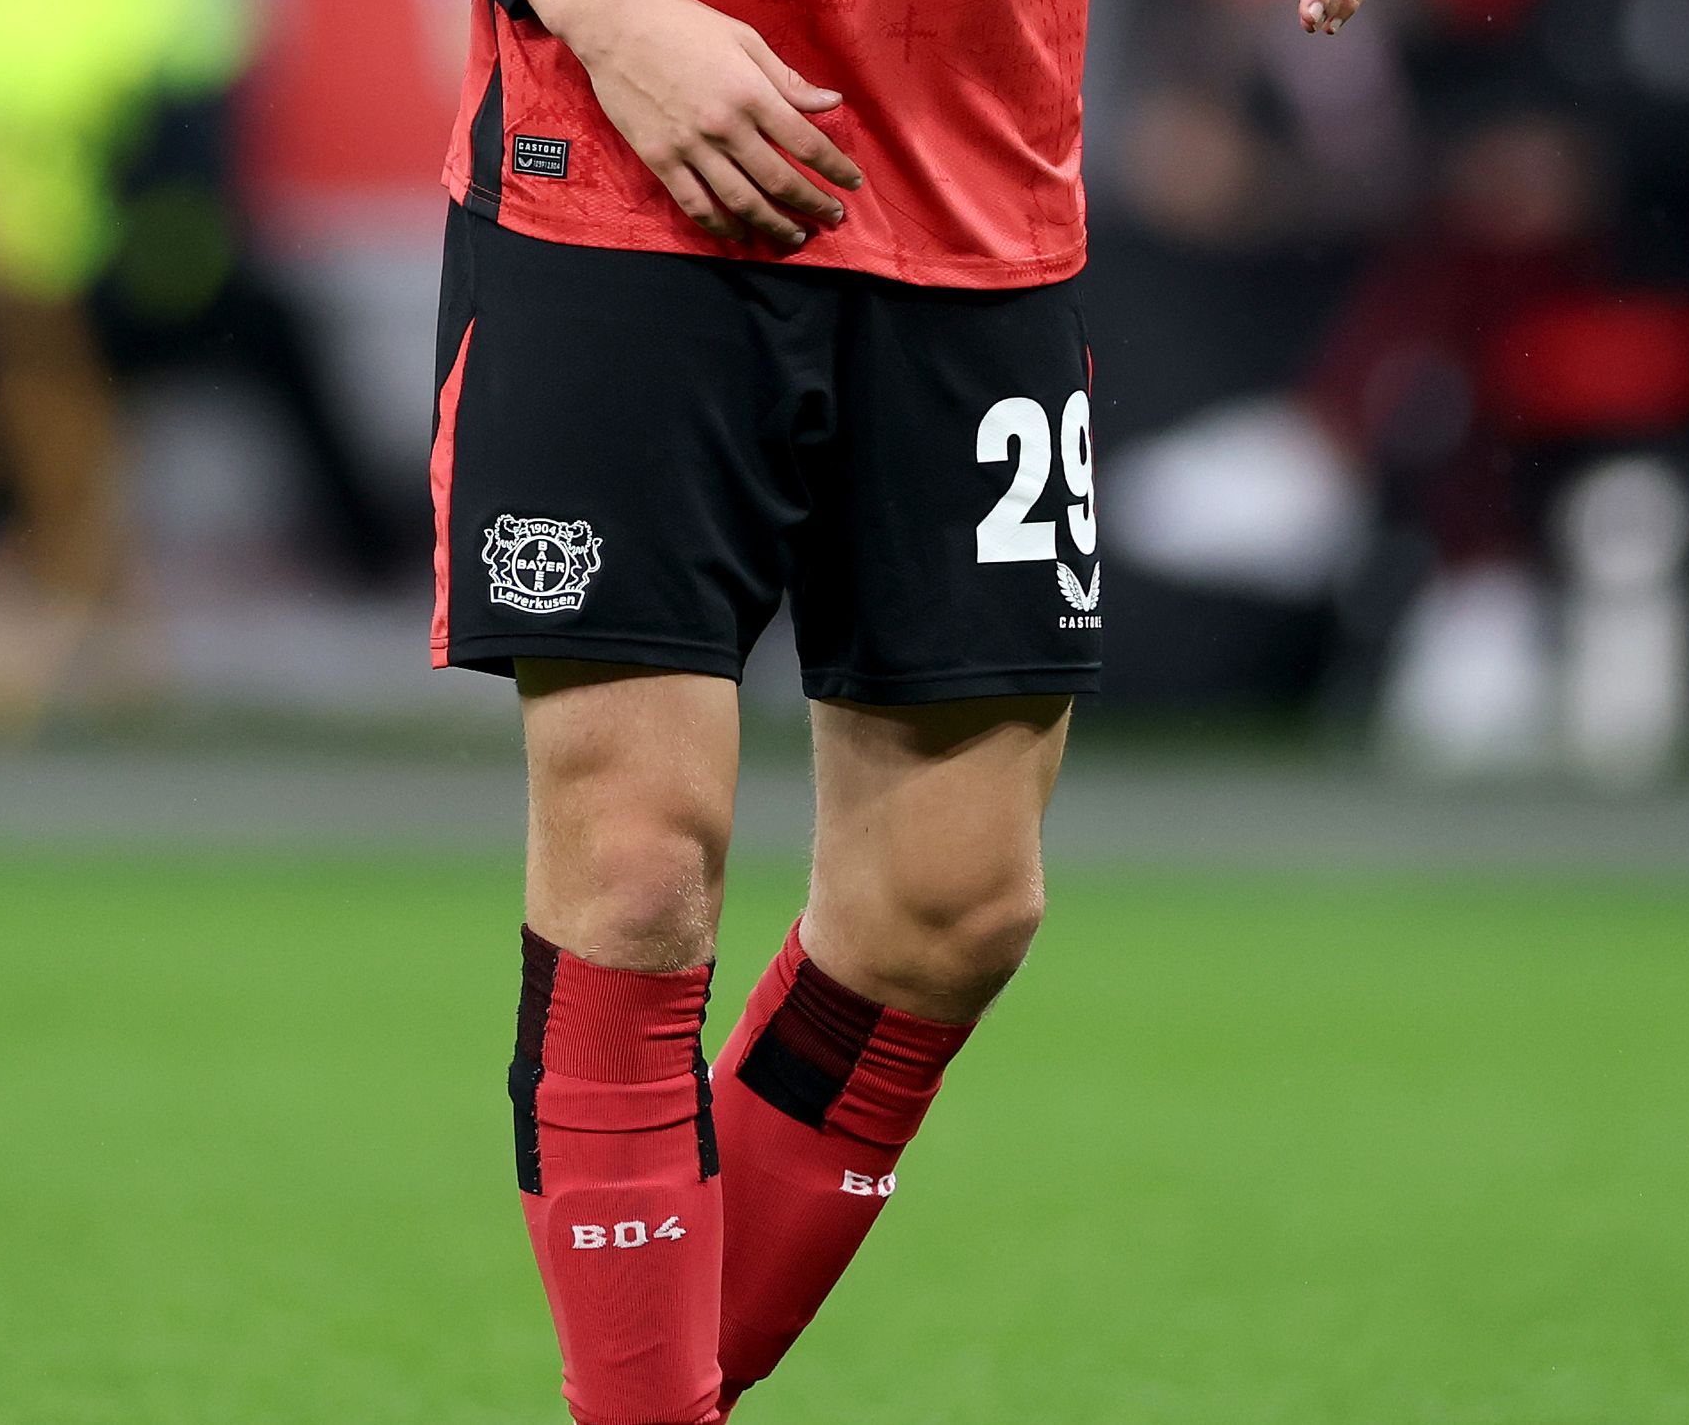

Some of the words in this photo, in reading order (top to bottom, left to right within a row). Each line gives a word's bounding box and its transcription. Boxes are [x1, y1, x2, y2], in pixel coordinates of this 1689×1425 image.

[518, 142, 562, 155] CASTORE
[976, 389, 1097, 564] 29
[530, 523, 556, 536] 1904
[516, 558, 565, 573] BAYER
[498, 587, 575, 609] Leverkusen
